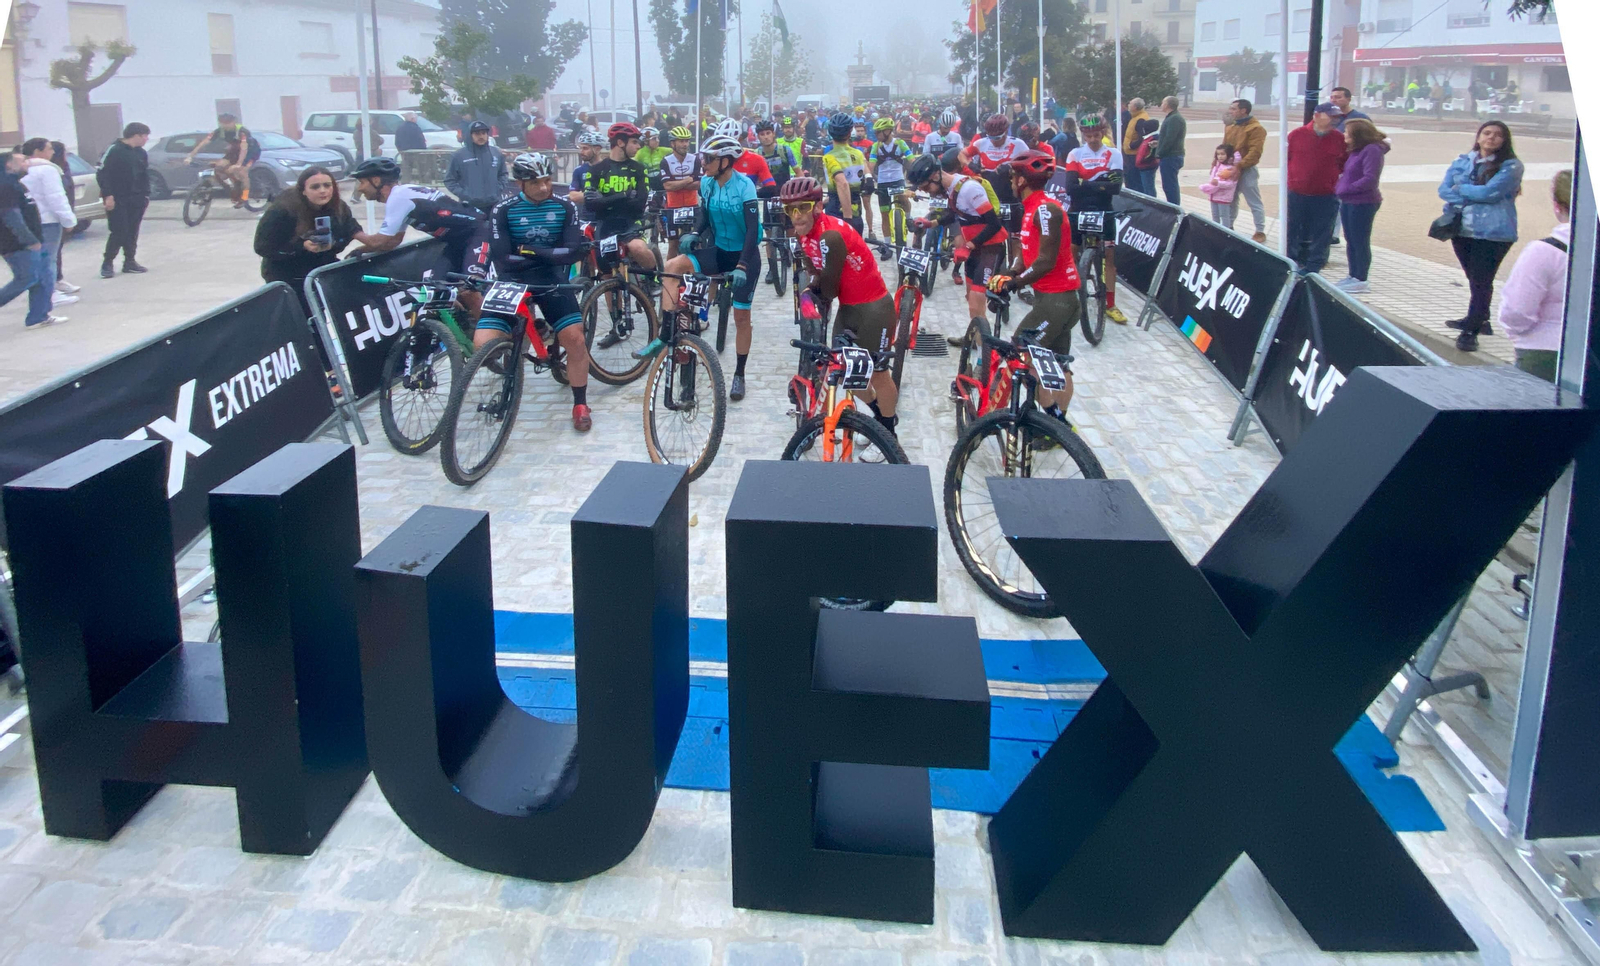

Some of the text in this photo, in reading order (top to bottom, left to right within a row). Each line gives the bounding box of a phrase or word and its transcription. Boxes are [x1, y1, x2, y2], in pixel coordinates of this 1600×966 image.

[1086, 215, 1096, 223] 22
[1122, 226, 1161, 258] EXTREMA
[496, 289, 514, 300] 24
[695, 283, 704, 295] 11
[1178, 251, 1251, 319] HUEX MTB
[345, 268, 433, 351] HUE
[858, 359, 863, 374] 1
[1043, 359, 1053, 373] 3
[1289, 338, 1348, 417] HUE
[208, 341, 302, 430] EXTREMA
[5, 367, 1588, 952] HUEX
